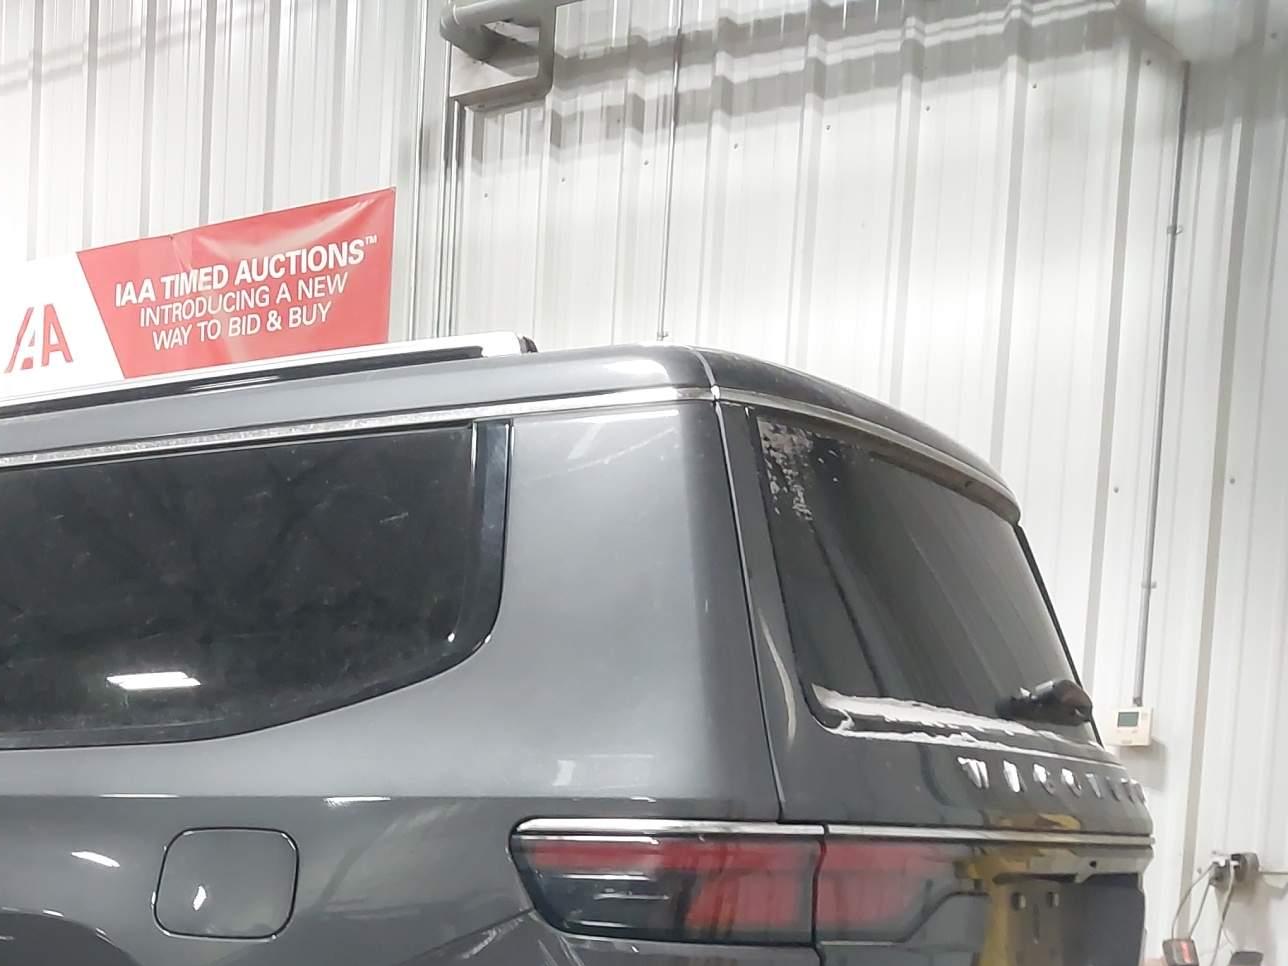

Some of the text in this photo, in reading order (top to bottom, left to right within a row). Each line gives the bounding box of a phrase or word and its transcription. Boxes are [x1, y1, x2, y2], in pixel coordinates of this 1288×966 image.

[115, 279, 156, 306] IAA
[161, 264, 229, 300] TIMED
[140, 272, 348, 327] INTRODUCING A NEW
[152, 301, 332, 350] WAY TO BID & BUY
